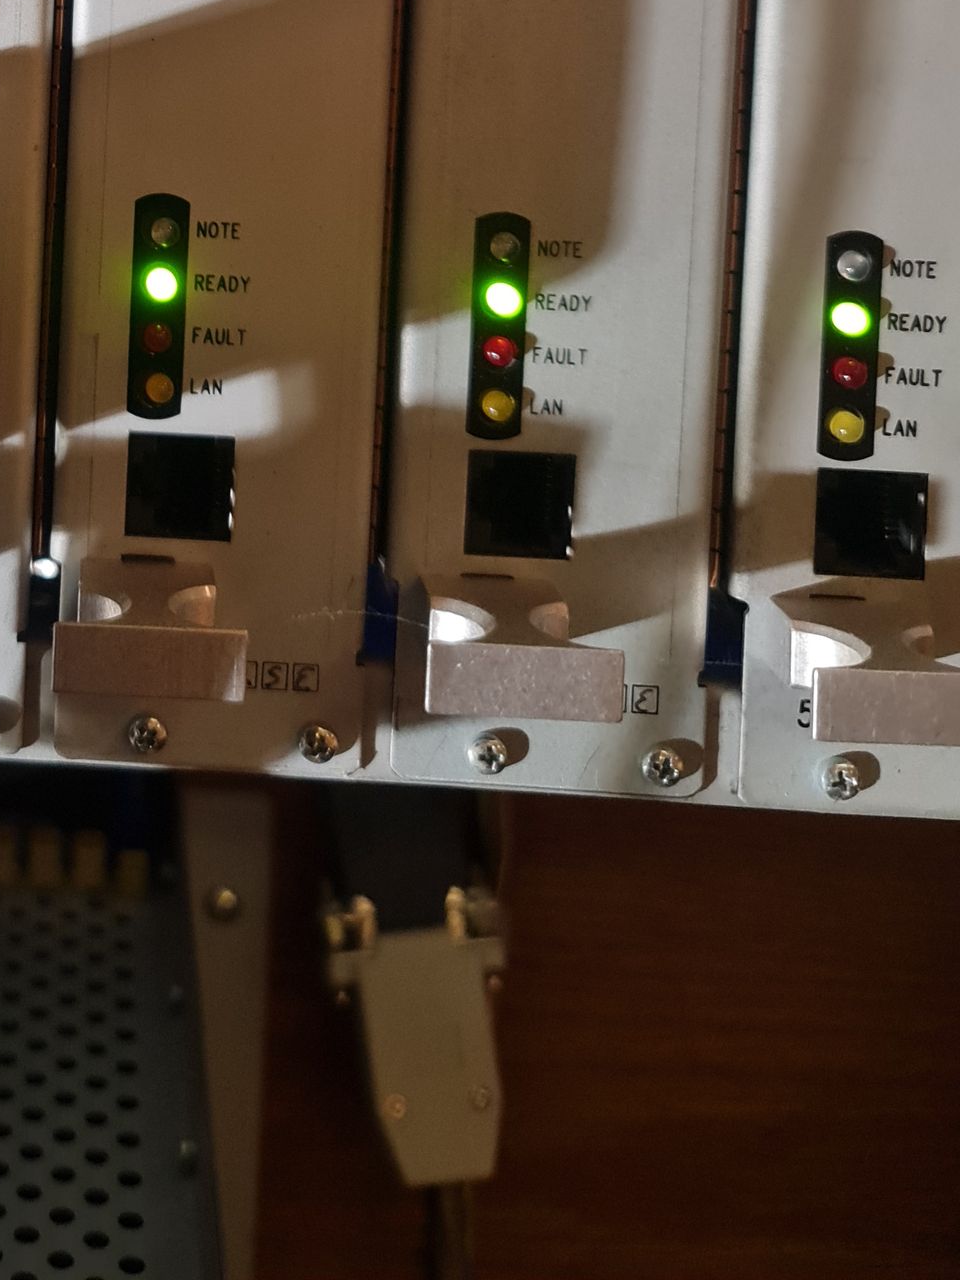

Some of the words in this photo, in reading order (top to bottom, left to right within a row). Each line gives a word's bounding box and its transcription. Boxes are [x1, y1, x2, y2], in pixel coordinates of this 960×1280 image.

[196, 221, 240, 240] NOTE
[537, 239, 584, 258] NOTE
[890, 260, 936, 280] NOTE
[194, 274, 250, 294] READY
[535, 293, 593, 313] READY
[887, 313, 947, 334] READY
[191, 327, 246, 346] FAULT
[532, 346, 589, 366] FAULT
[190, 378, 223, 396] LAN
[884, 368, 942, 388] FAULT
[530, 399, 564, 416] LAN
[882, 418, 918, 438] LAN
